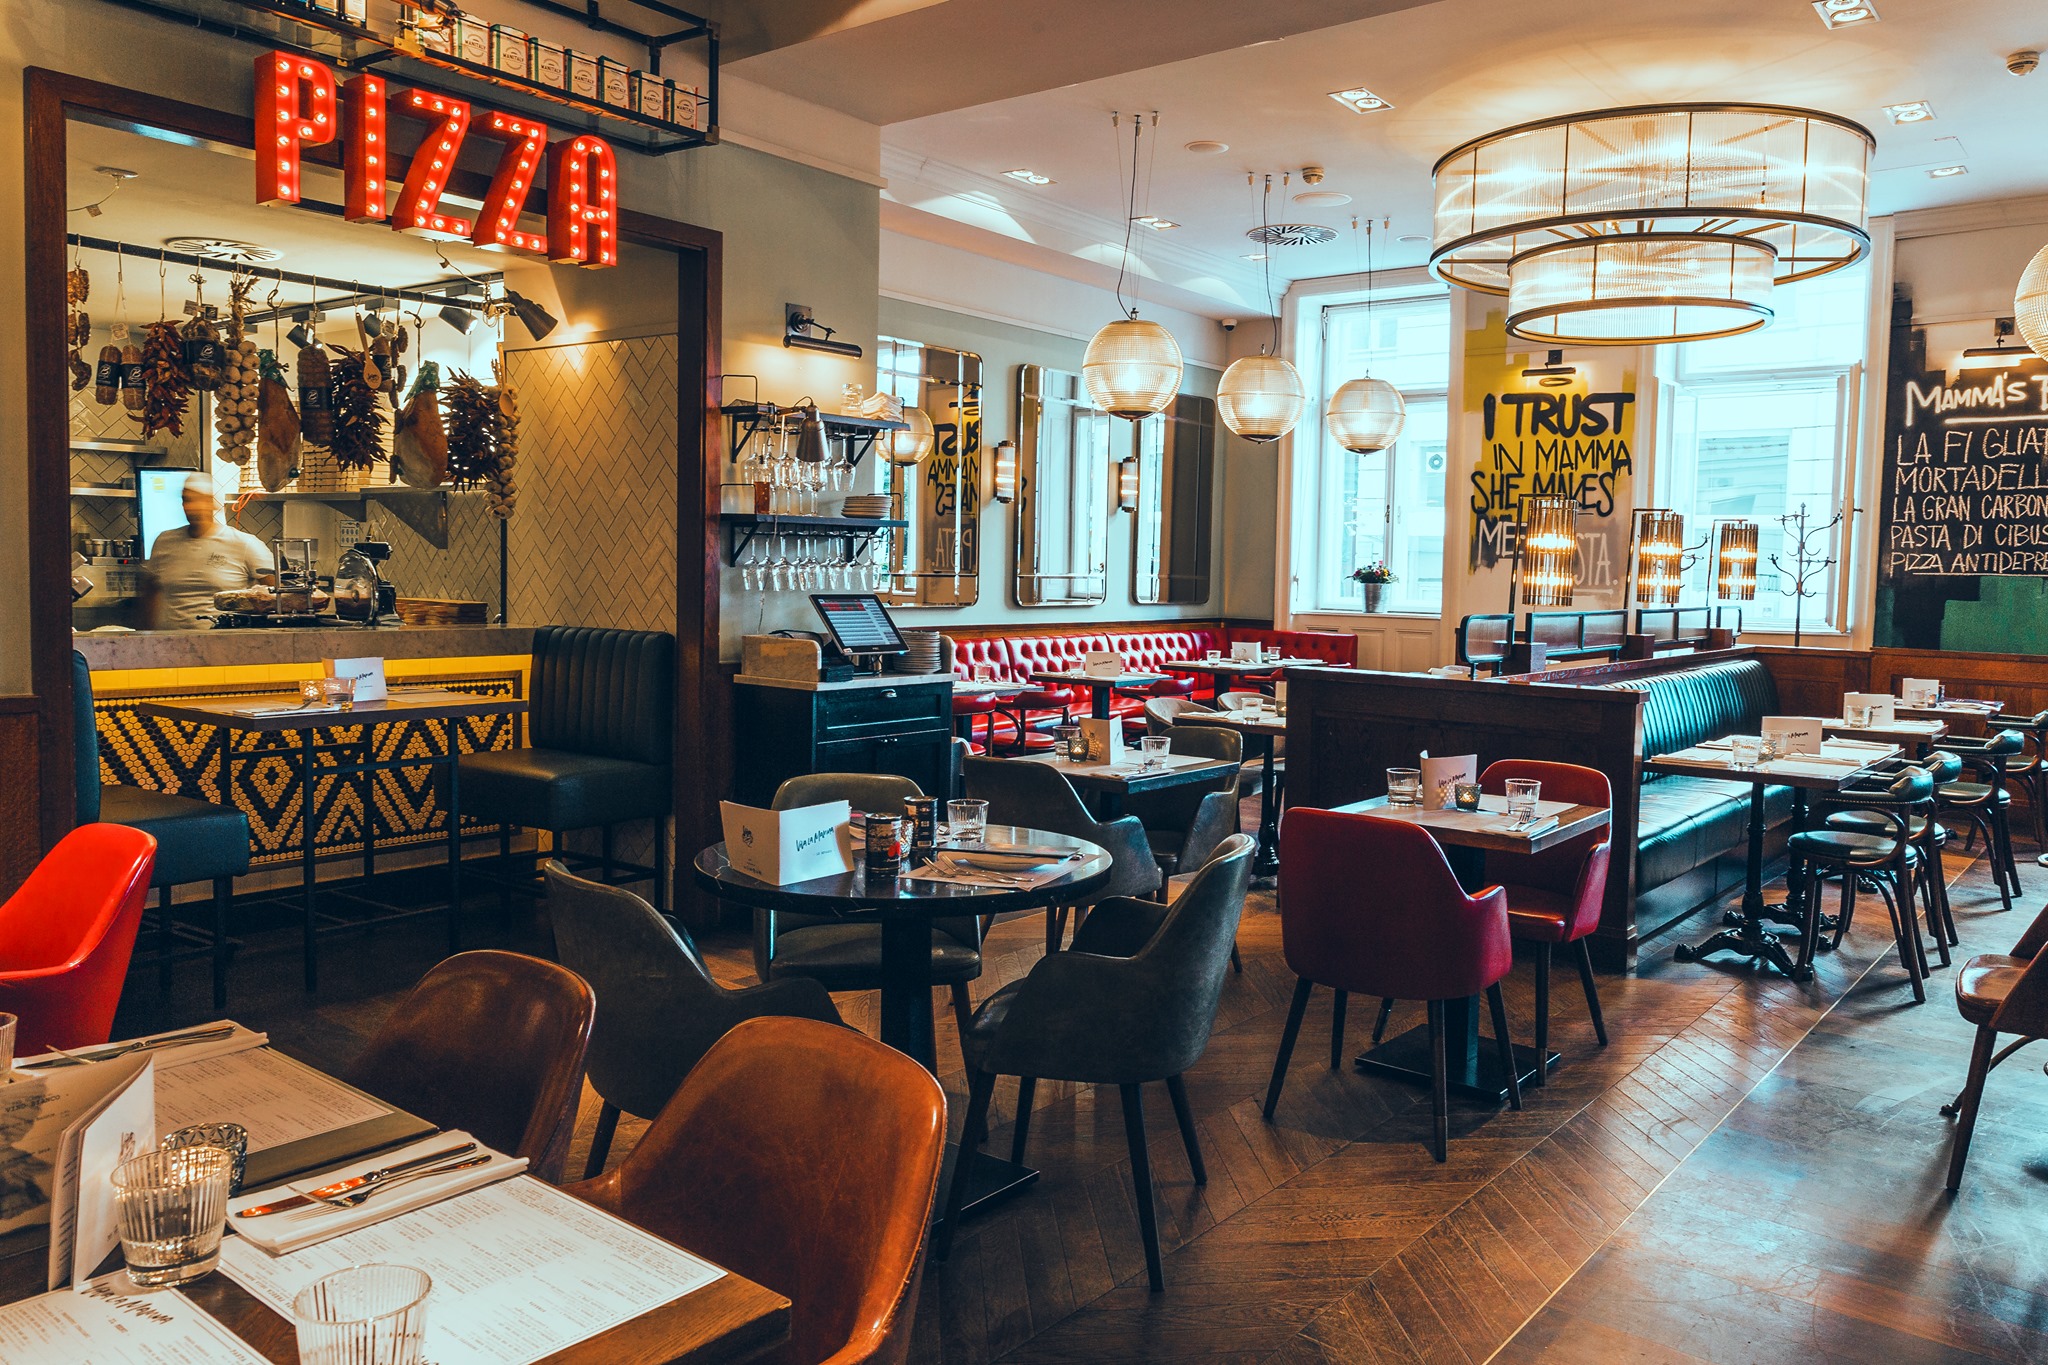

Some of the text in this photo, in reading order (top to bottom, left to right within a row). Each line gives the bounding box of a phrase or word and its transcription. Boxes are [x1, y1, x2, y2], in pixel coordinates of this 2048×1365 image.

[464, 39, 487, 51] MANITALY
[502, 52, 525, 64] MANITALY
[540, 63, 562, 74] MANITALY
[254, 50, 617, 269] PIZZA
[1484, 392, 1635, 441] I TRUST
[1493, 439, 1632, 476] IN MAMMA
[1897, 432, 1932, 466] LA
[1471, 471, 1614, 517] SHE MAKES
[1895, 463, 2048, 494] MORTADELL
[1893, 494, 2048, 523] LA GRAN CARBON
[1891, 524, 1951, 551] PASTA
[1963, 524, 1982, 549] DI
[1574, 532, 1619, 587] STA.
[1890, 552, 1944, 578] PIZZA
